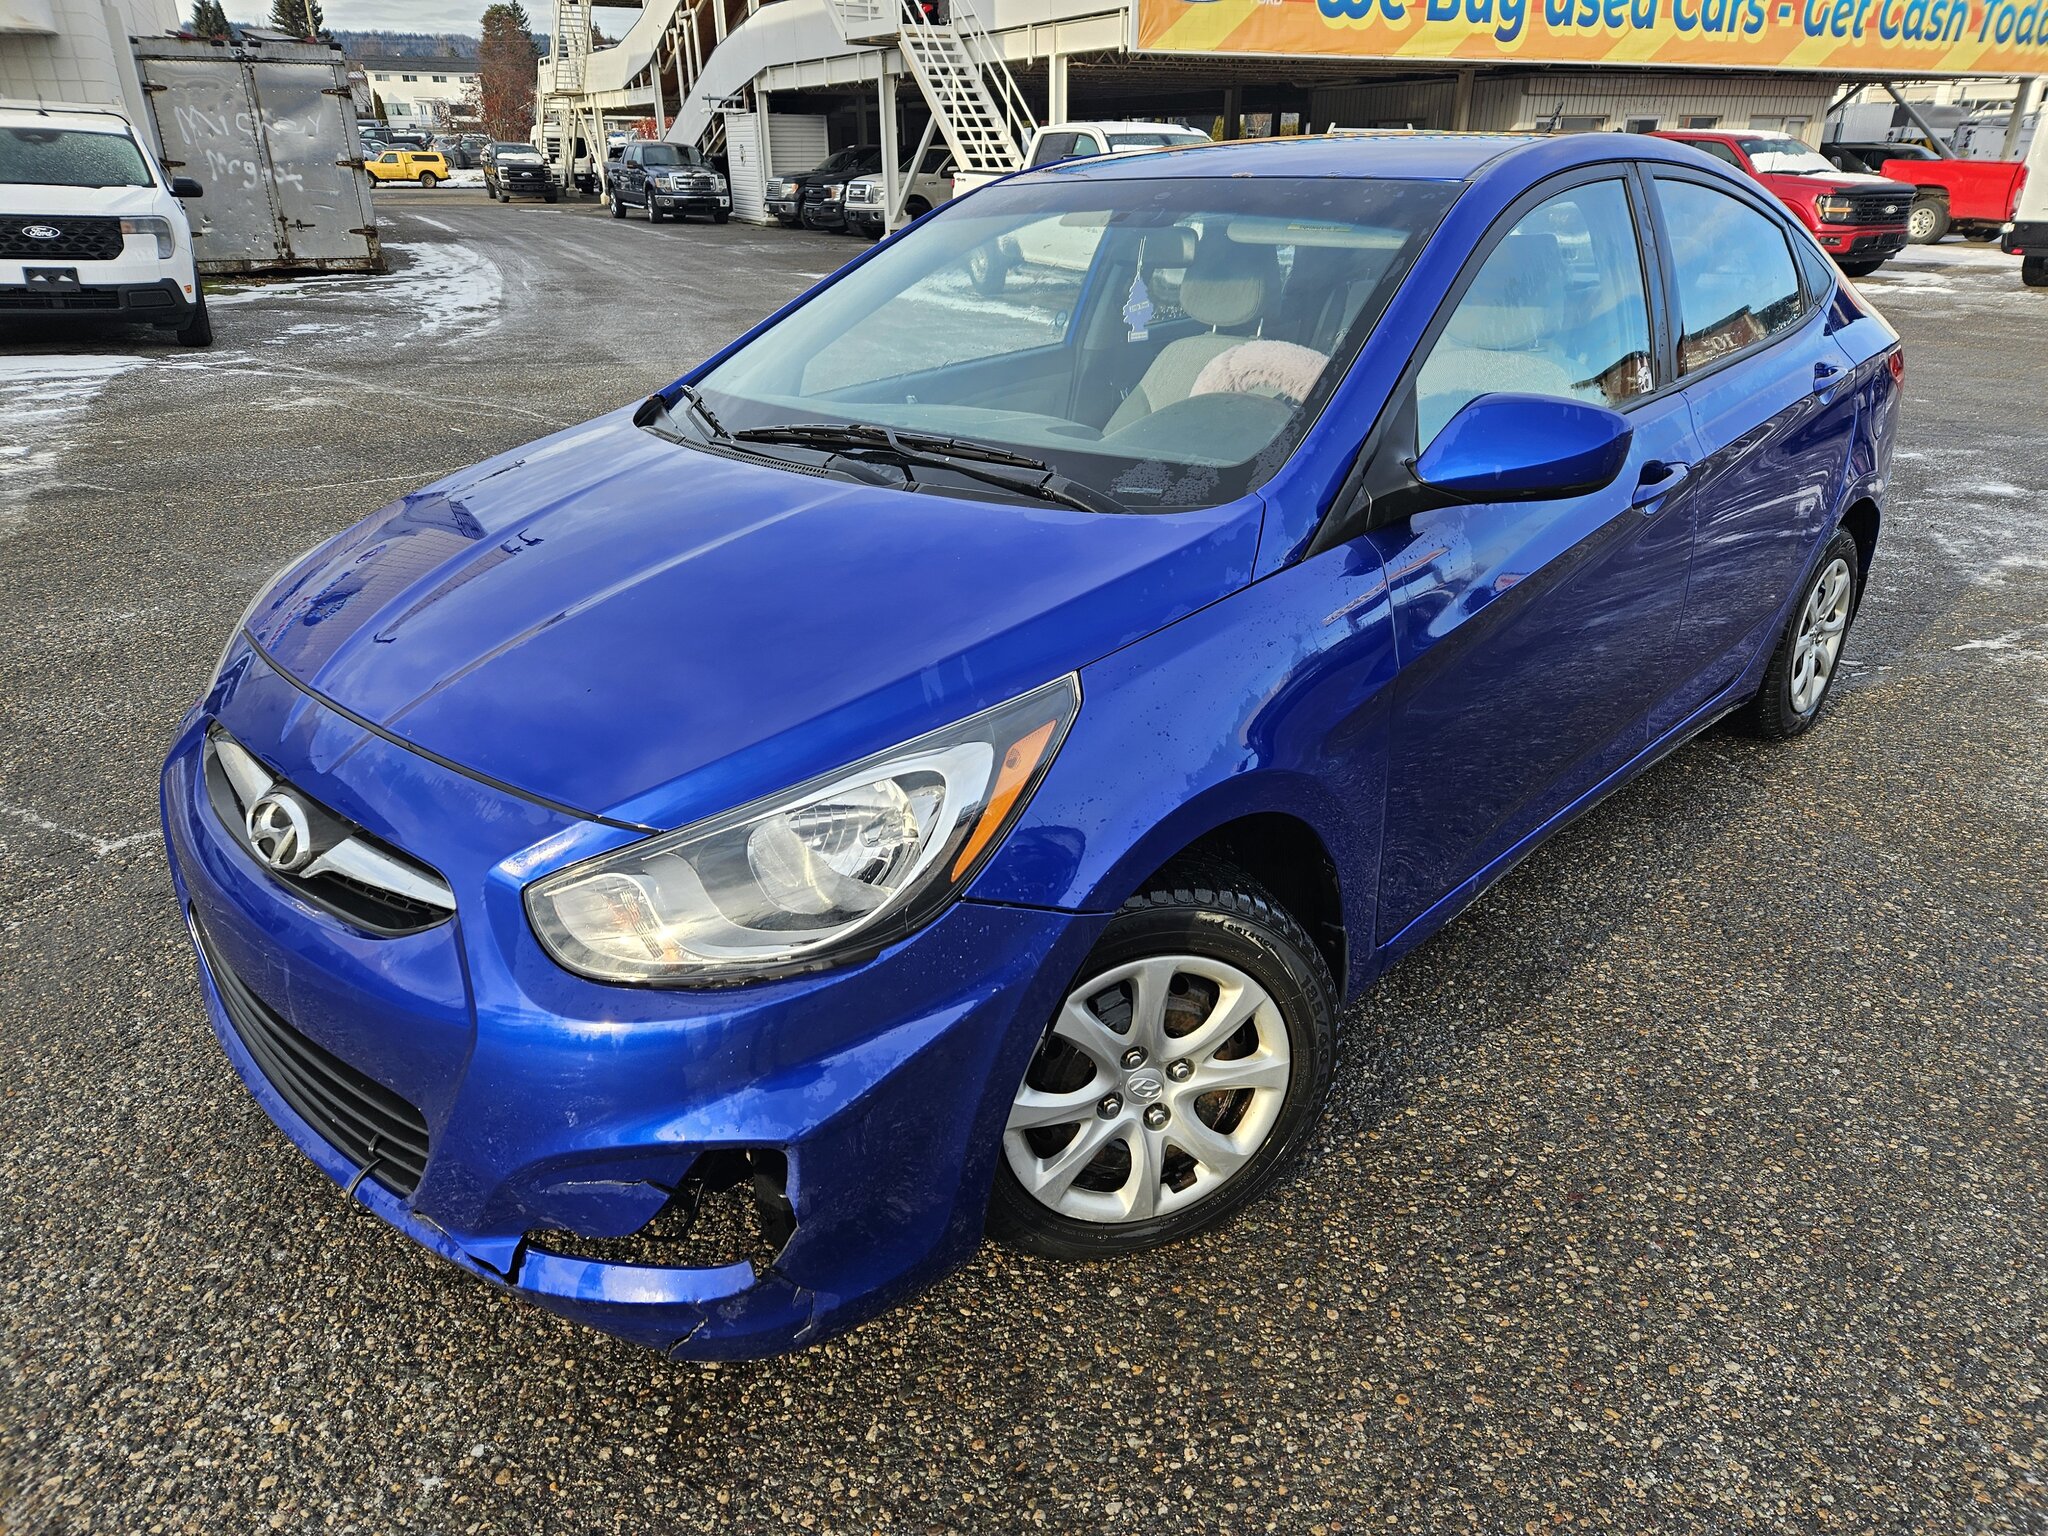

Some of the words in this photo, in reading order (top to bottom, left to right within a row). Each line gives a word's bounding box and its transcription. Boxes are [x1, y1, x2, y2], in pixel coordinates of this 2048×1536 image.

[1671, 0, 1765, 34] Cars
[1804, 0, 1869, 38] Get
[1879, 0, 1969, 42] Cash
[28, 226, 54, 237] Ford
